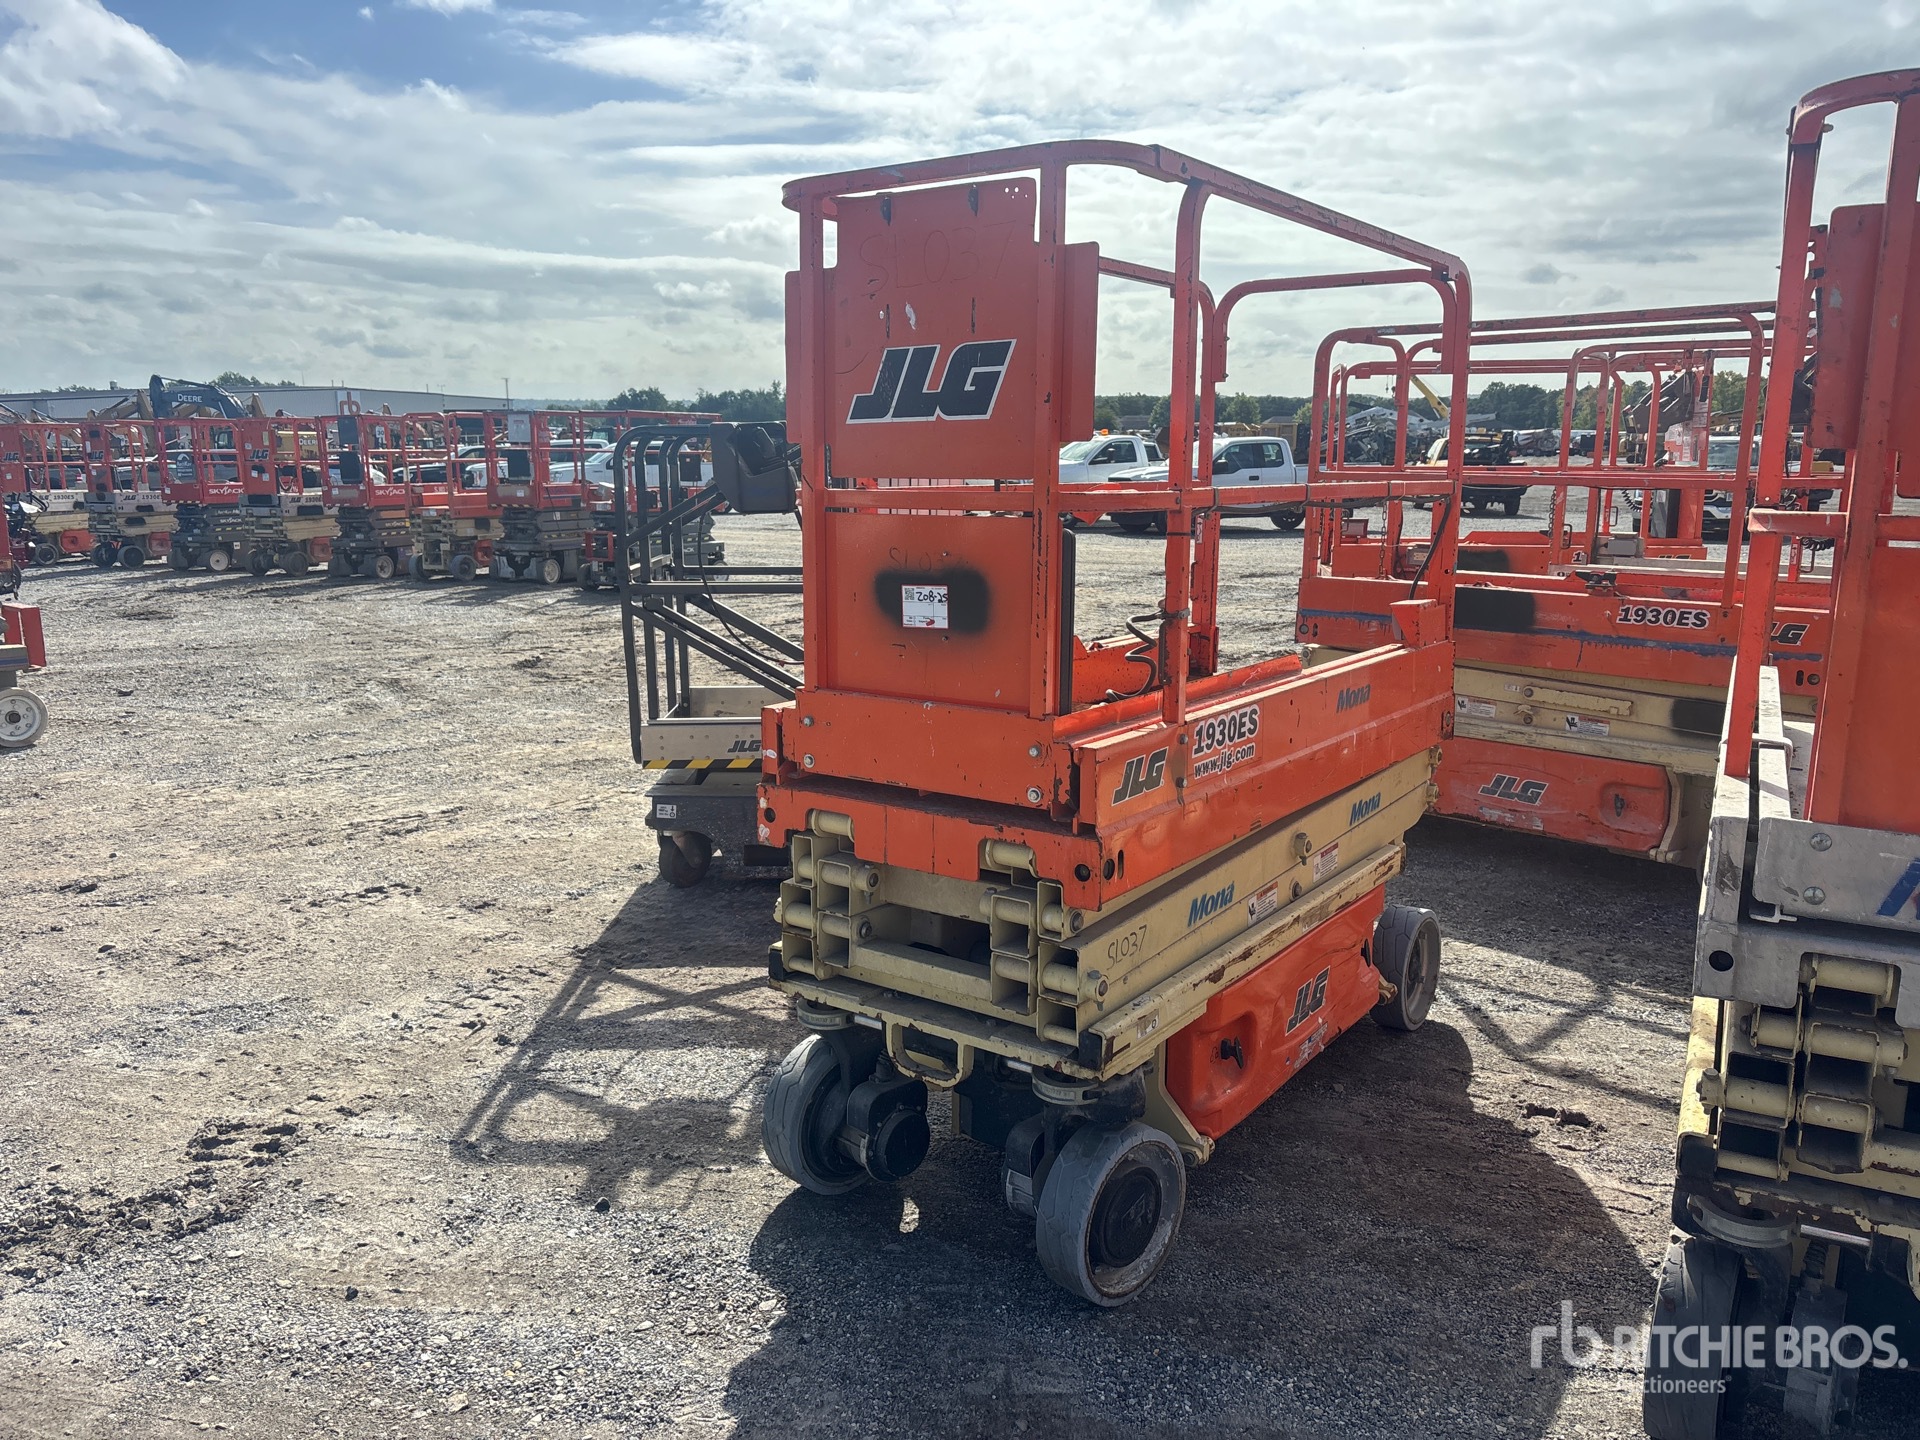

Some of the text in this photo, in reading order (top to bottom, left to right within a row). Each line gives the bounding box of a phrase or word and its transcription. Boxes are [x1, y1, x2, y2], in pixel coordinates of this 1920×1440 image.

[177, 393, 203, 403] DEERE
[846, 338, 1017, 424] JLG
[250, 449, 269, 460] JLG
[299, 438, 318, 446] DEER
[1616, 604, 1710, 630] 1930ES
[1336, 684, 1371, 714] Mona
[727, 739, 761, 753] JLG
[1192, 704, 1260, 758] 1930ES
[1111, 746, 1169, 807] JLG
[1193, 742, 1256, 780] www.jlg.com
[1478, 772, 1549, 806] JLG
[1349, 792, 1382, 827] Mona
[1187, 880, 1236, 928] Mona
[1284, 965, 1331, 1037] JLG
